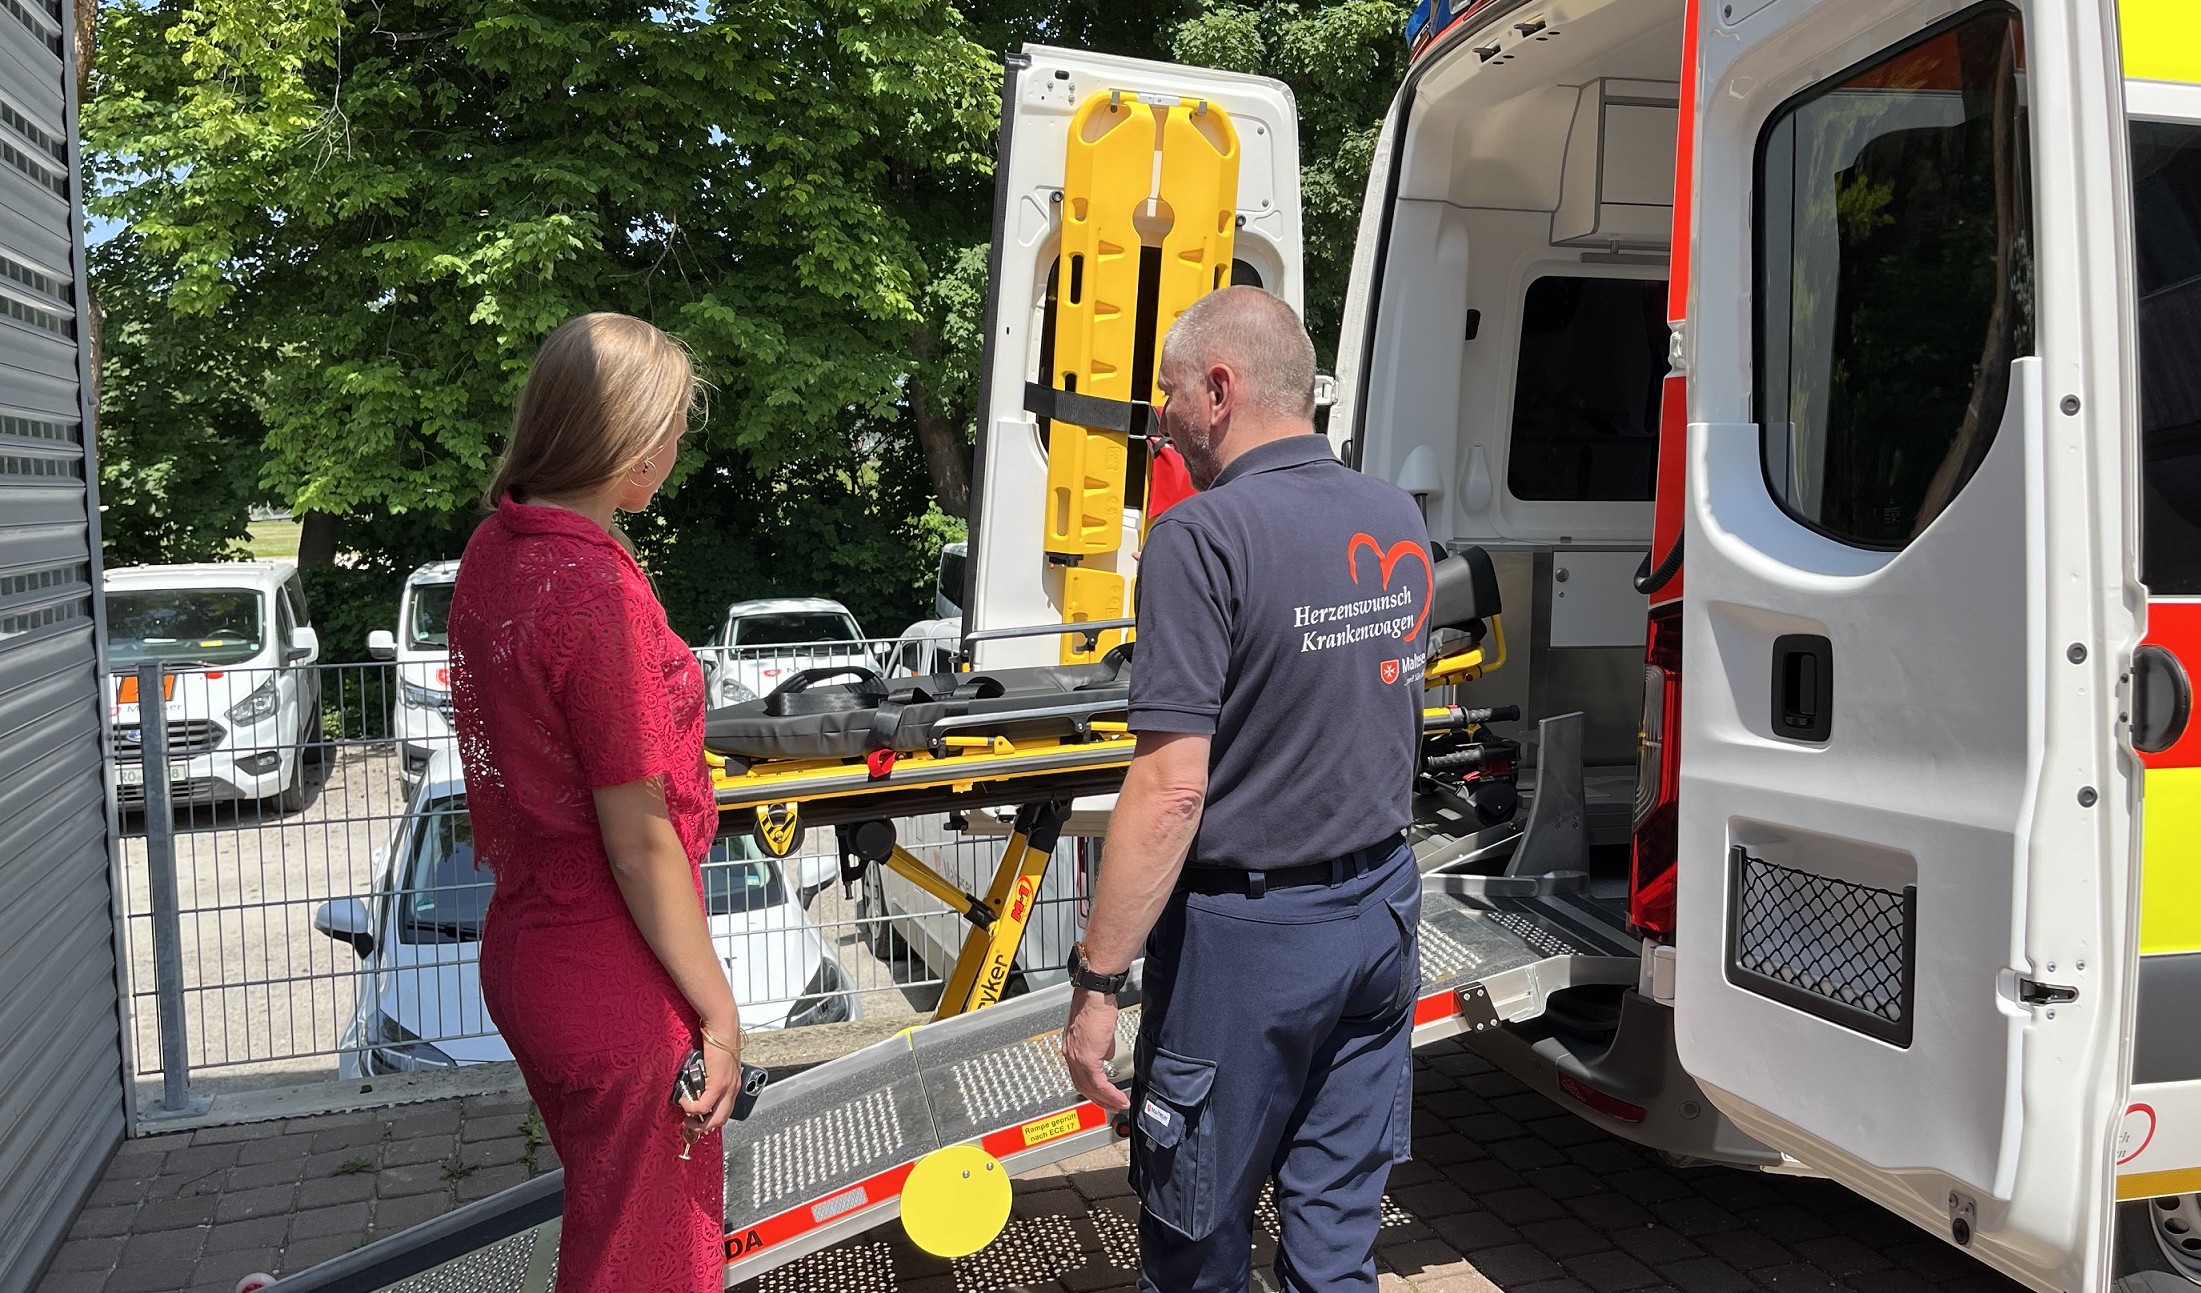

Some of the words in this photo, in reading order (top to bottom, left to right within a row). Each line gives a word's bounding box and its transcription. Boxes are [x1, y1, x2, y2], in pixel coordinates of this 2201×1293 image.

[1293, 585, 1412, 628] Herzenswunsch
[1301, 613, 1414, 653] Krankenwagen
[1401, 653, 1426, 674] Maltese
[1010, 884, 1030, 923] M-1
[977, 954, 1008, 1009] yker
[1024, 1123, 1050, 1135] Rampe
[1051, 1113, 1077, 1128] geprüft
[1030, 1132, 1048, 1142] nach
[1049, 1126, 1065, 1136] ECE
[1066, 1122, 1075, 1130] 17
